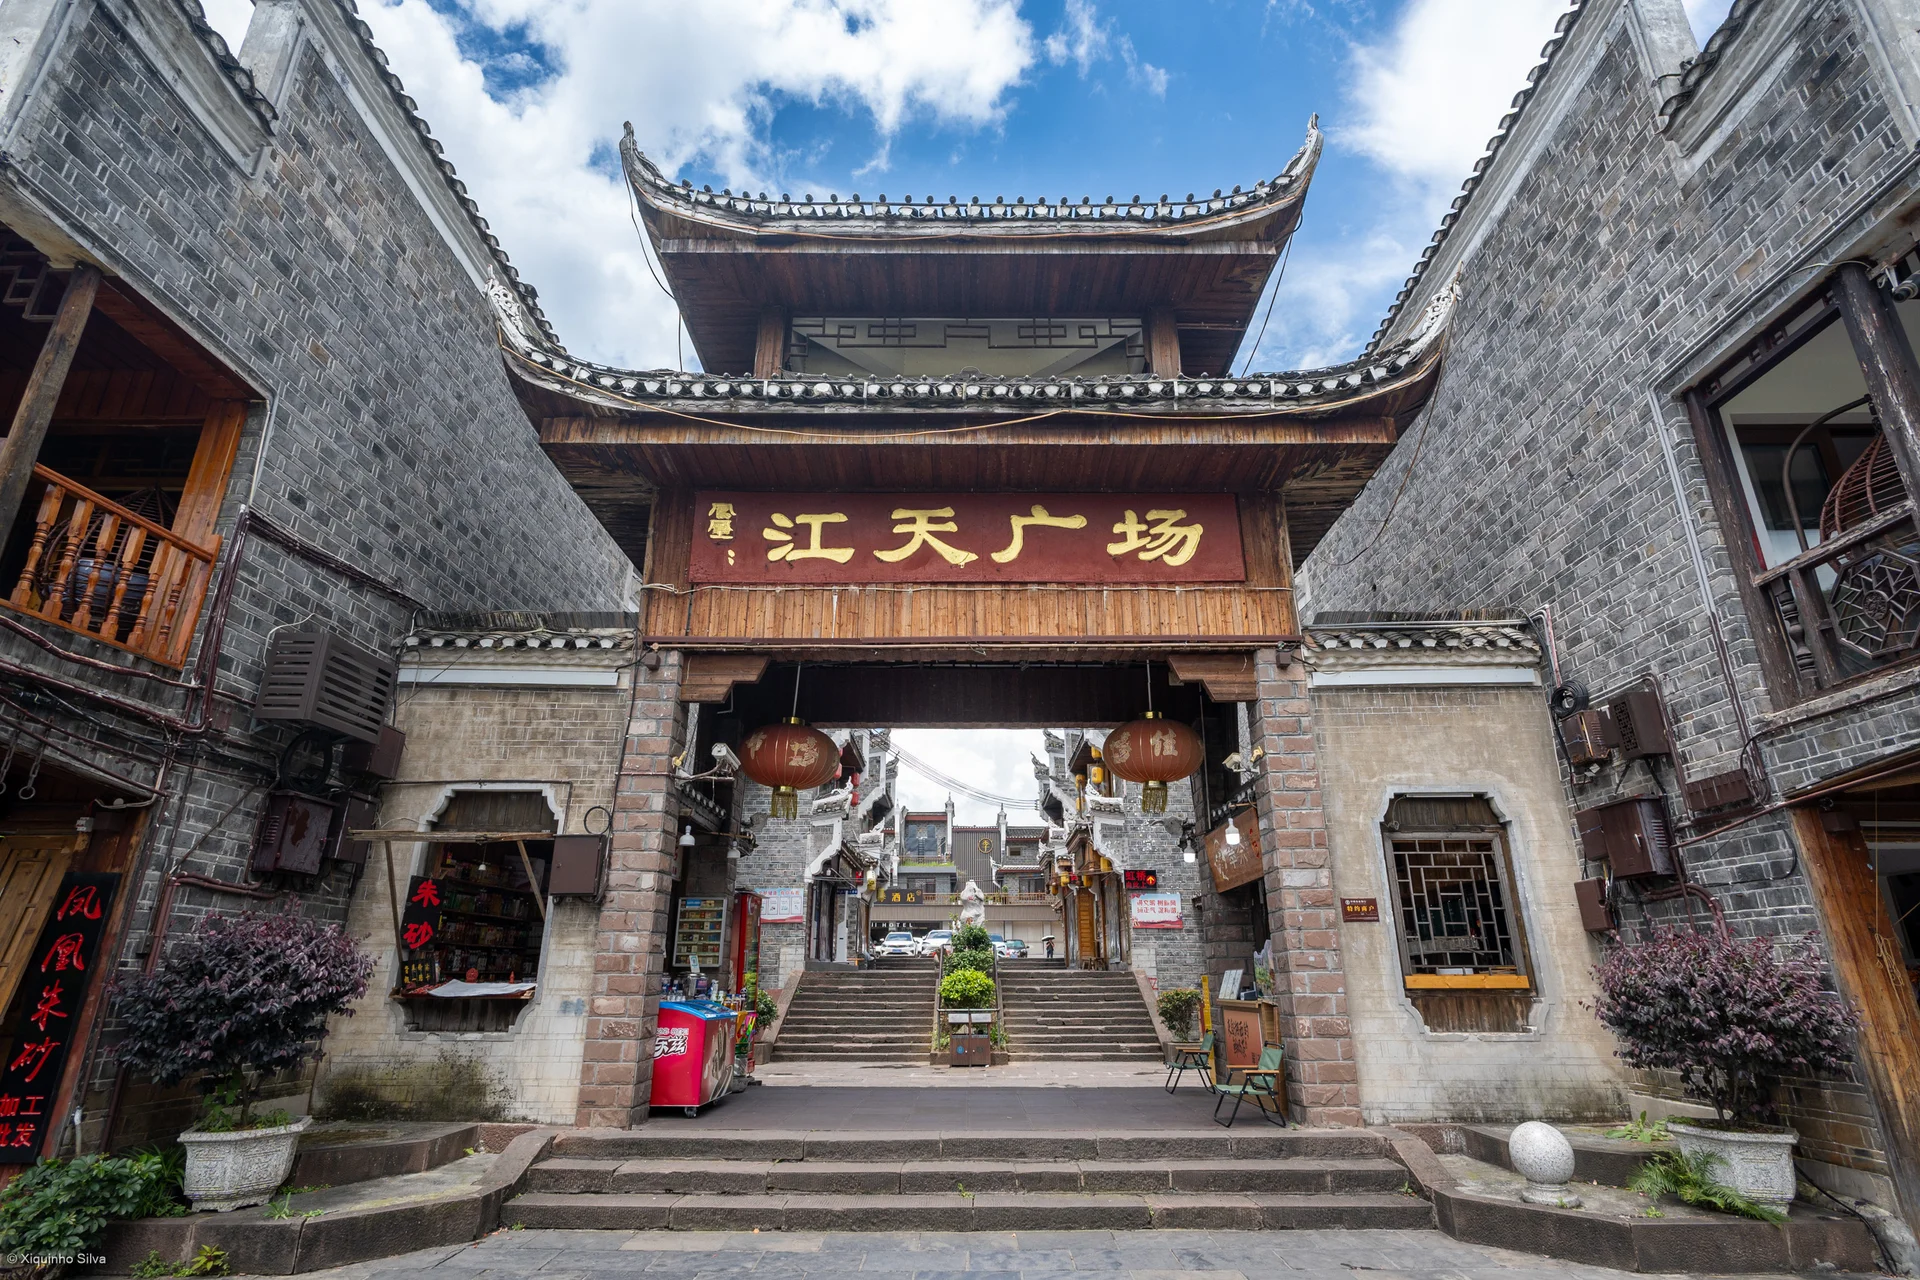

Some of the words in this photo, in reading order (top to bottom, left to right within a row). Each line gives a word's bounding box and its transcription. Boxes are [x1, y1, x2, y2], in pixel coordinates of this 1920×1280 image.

[763, 505, 1203, 567] 江天广场
[403, 879, 441, 949] 朱砂
[11, 885, 102, 1083] 凤凰朱砂
